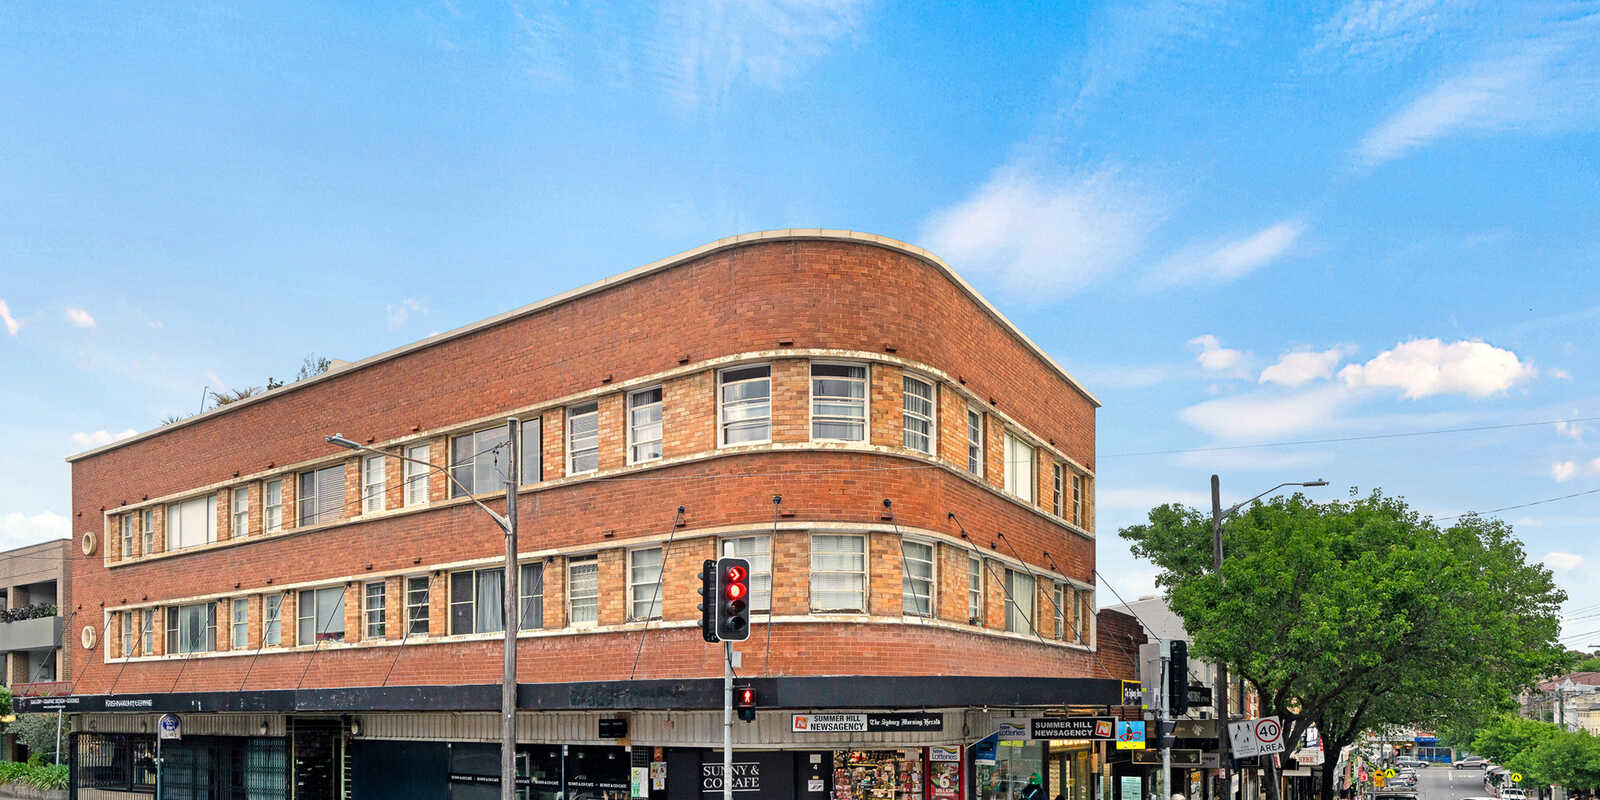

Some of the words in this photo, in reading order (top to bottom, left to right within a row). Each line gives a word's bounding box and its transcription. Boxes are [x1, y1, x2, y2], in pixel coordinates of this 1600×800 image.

[810, 722, 864, 731] NEWSAGENCY
[881, 718, 900, 727] Sydney
[901, 718, 922, 726] Morning
[924, 718, 941, 726] Herald
[1035, 721, 1071, 729] SUMMER
[1034, 729, 1093, 737] NEWSAGENCY
[1259, 724, 1278, 737] 40
[1260, 743, 1284, 753] AREA
[750, 764, 760, 775] &
[703, 777, 723, 789] CO
[726, 777, 760, 788] AFE
[939, 771, 951, 788] 6
